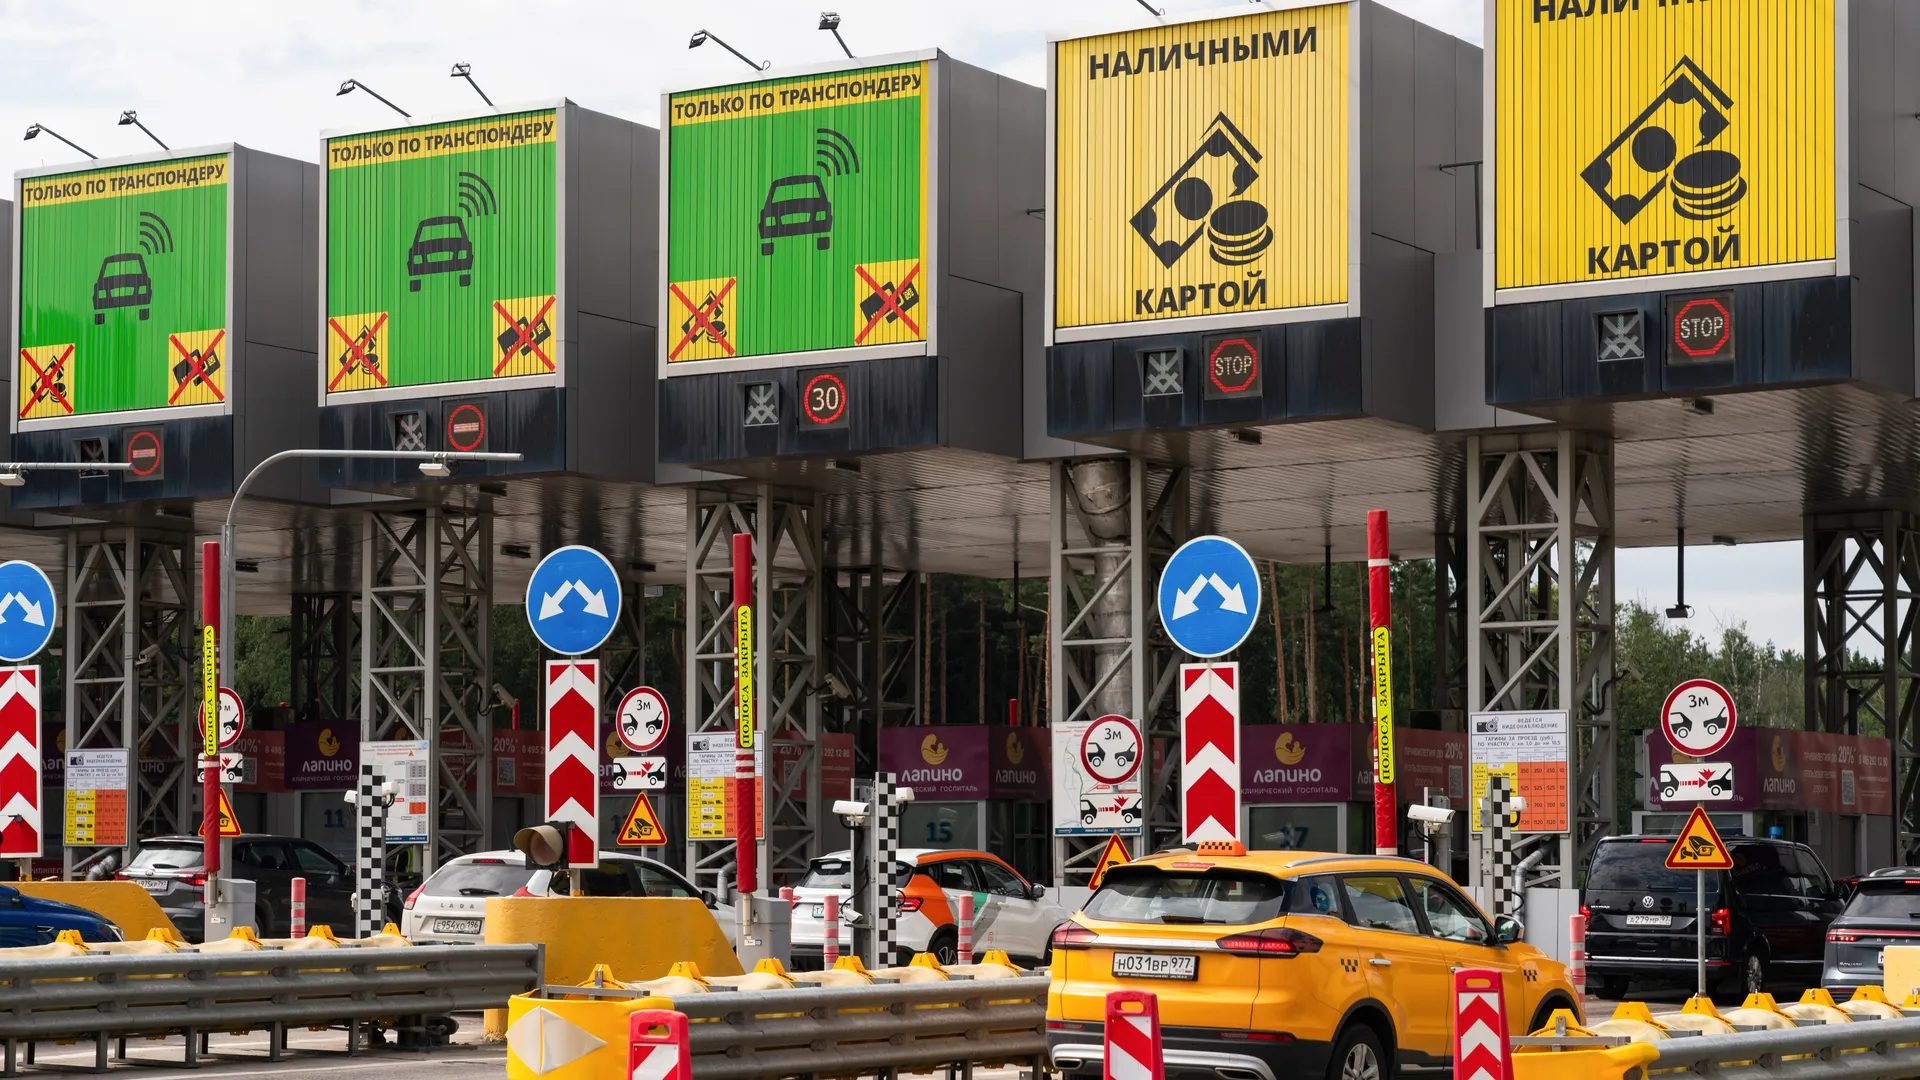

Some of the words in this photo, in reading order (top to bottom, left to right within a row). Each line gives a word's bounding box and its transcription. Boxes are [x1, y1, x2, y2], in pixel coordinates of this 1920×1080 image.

[1090, 26, 1317, 81] НАЛИЧНЫМИ
[674, 95, 745, 120] ТОЛЬКО
[749, 91, 775, 111] ПО
[779, 72, 922, 107] ТРАНСПОНДЕРУ
[331, 140, 394, 163] ТОЛЬКО
[397, 136, 421, 155] ПО
[424, 120, 554, 152] ТРАНСПОНДЕРУ
[25, 181, 82, 203] ТОЛЬКО
[85, 178, 106, 195] ПО
[109, 163, 225, 192] ТРАНСПОНДЕРУ
[1588, 224, 1740, 275] КАРТОЙ
[1135, 270, 1266, 315] КАРТОЙ
[1680, 316, 1724, 339] STOP
[1214, 356, 1252, 377] STOP
[812, 386, 839, 412] 30
[740, 609, 748, 678] ЗАКРЫТА
[1377, 631, 1387, 707] ЗАКРЫТА
[742, 684, 750, 744] ПОЛОСА
[1380, 714, 1390, 780] ПОЛОСА
[324, 808, 345, 828] 11
[926, 821, 953, 843] 15
[1281, 826, 1309, 848] 17
[436, 920, 465, 930] Е954ХО
[1118, 956, 1168, 972] Н031ВР
[1171, 957, 1191, 968] 977
